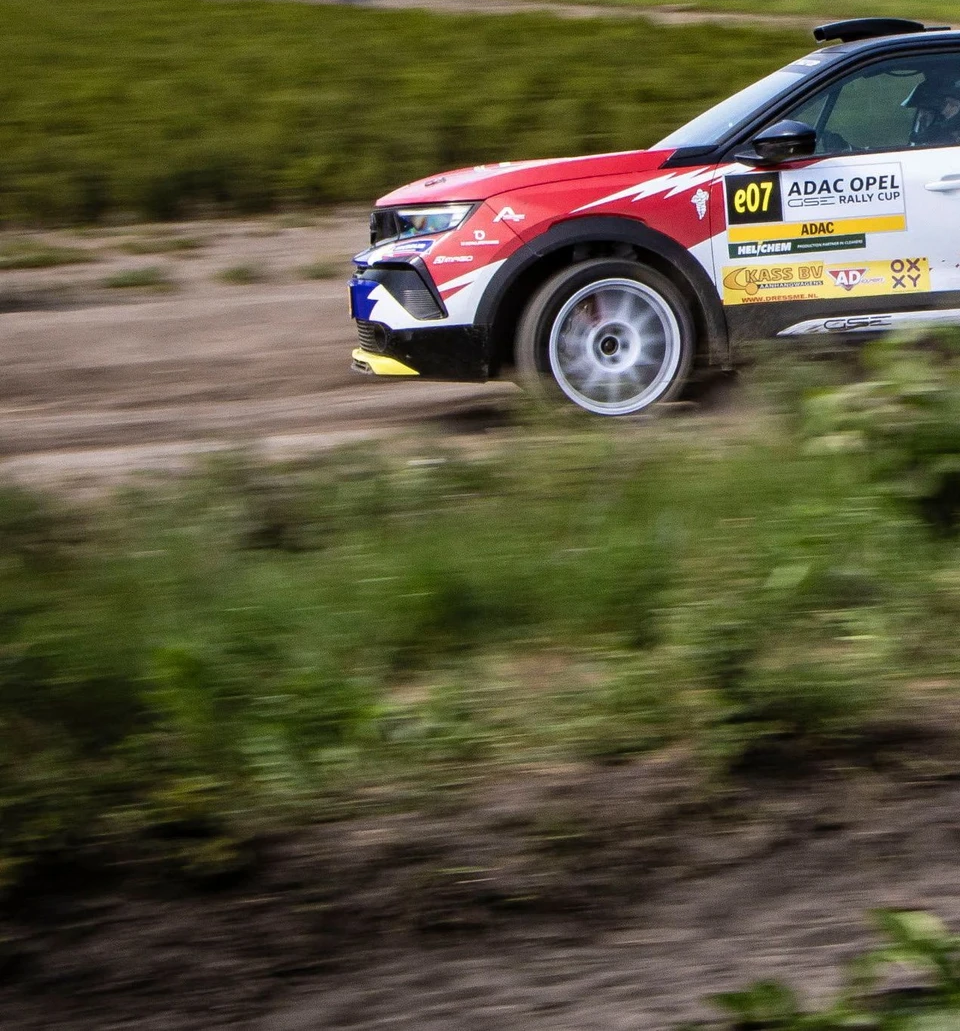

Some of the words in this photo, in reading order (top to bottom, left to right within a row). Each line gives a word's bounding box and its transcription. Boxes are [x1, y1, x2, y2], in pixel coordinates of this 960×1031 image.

[787, 177, 845, 197] ADAC
[849, 174, 900, 192] OPEL
[733, 181, 773, 214] e07
[839, 193, 874, 205] RALLY
[877, 191, 900, 202] CUP
[801, 222, 835, 236] ADAC
[744, 268, 793, 283] KASS
[798, 266, 824, 280] BV
[835, 270, 861, 286] AD
[759, 280, 824, 290] AANHANGWAGENS
[741, 293, 819, 303] WWW.DRESSME.NL
